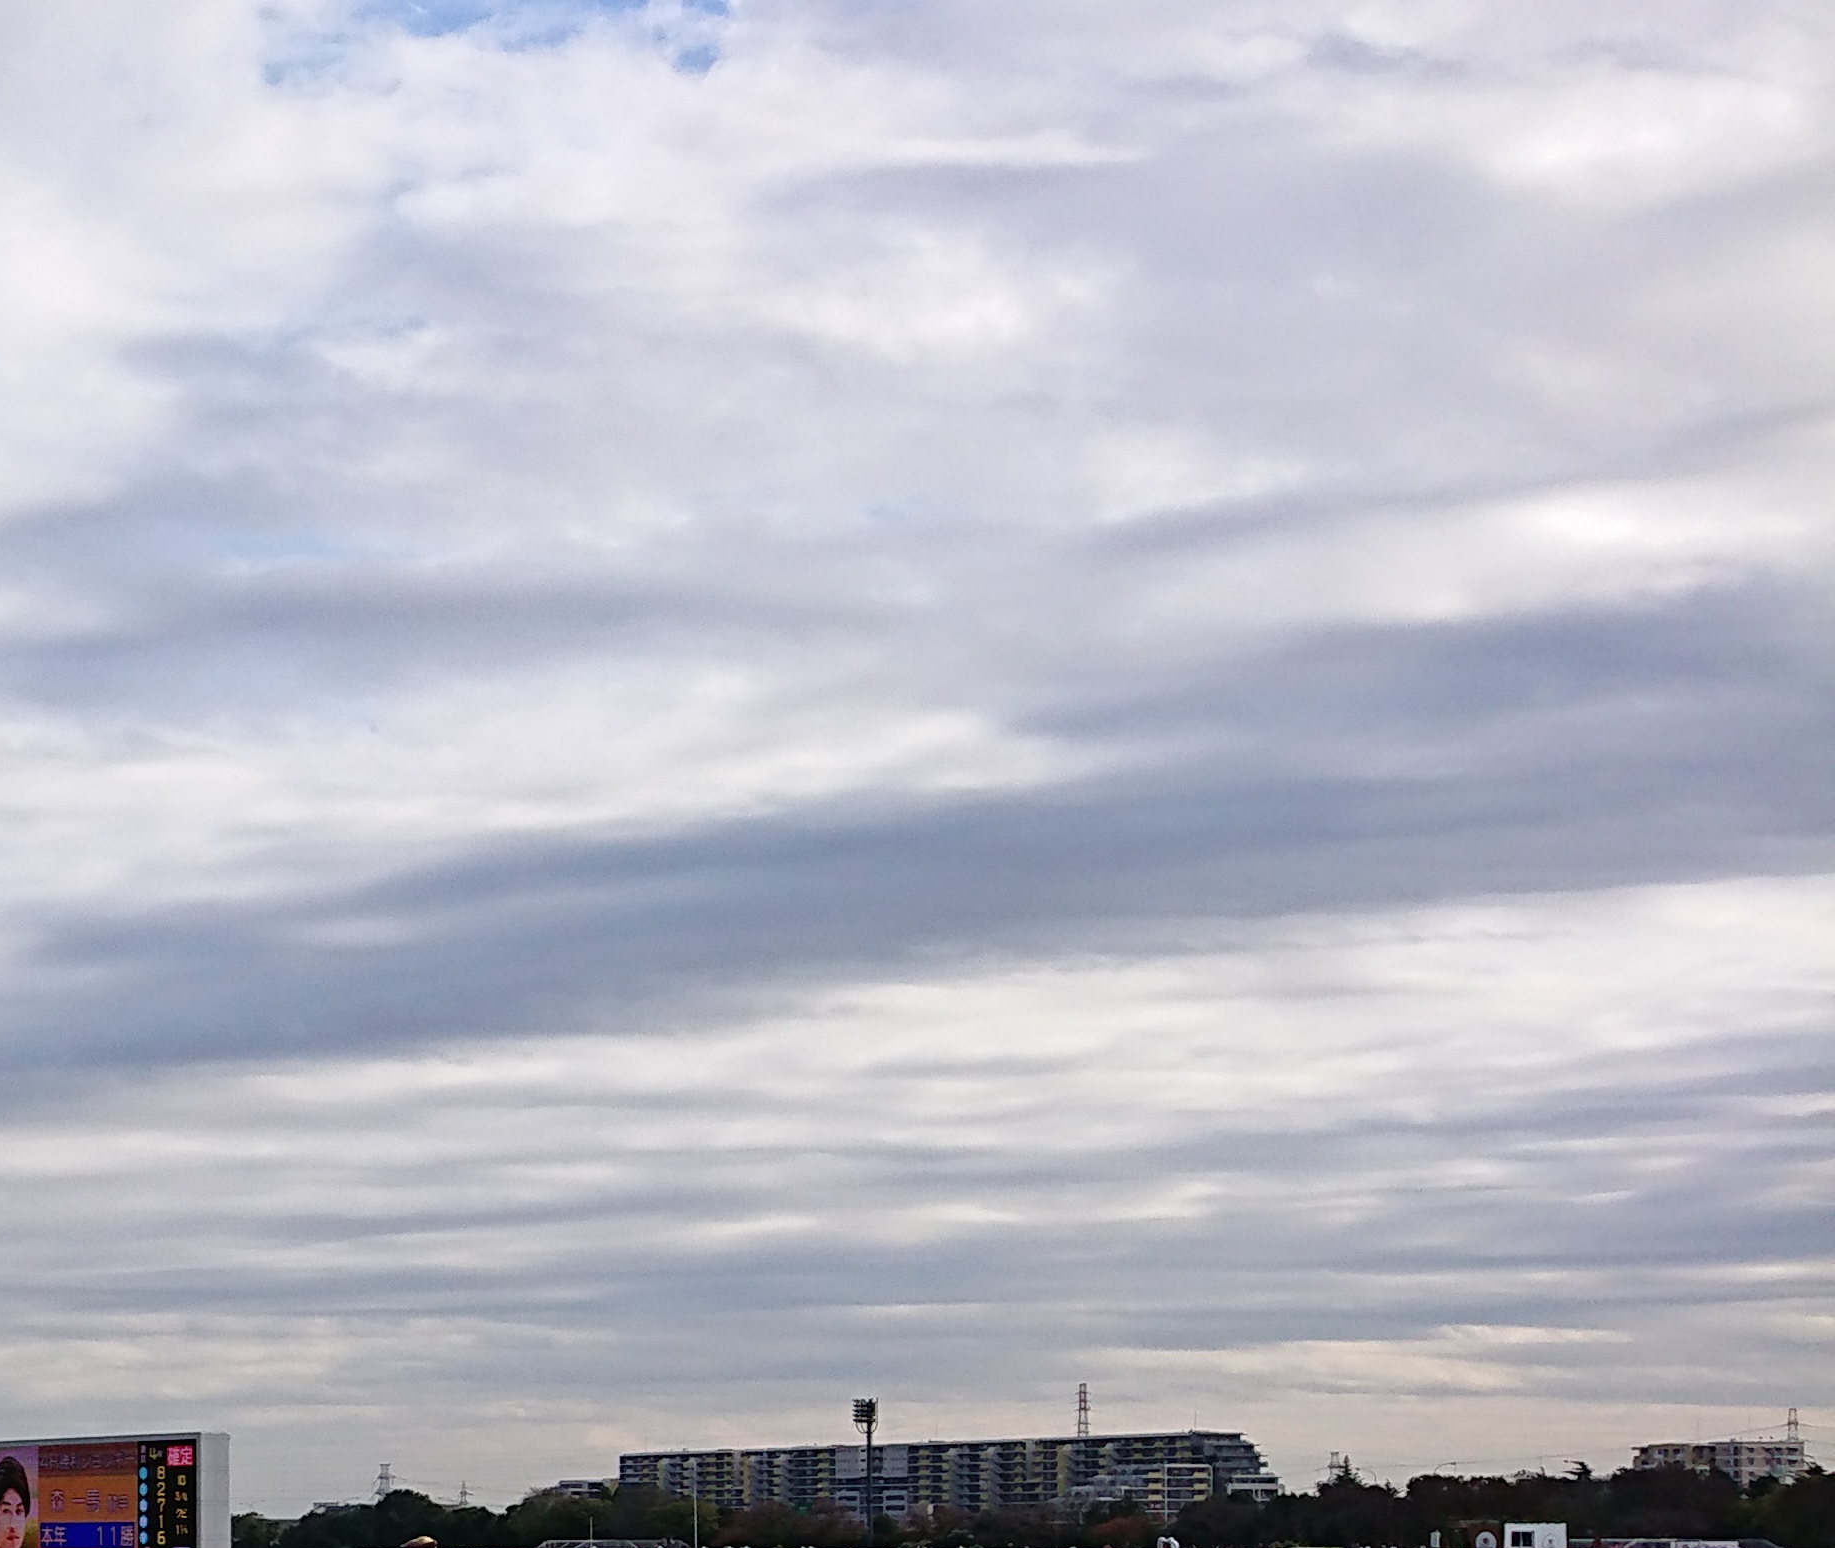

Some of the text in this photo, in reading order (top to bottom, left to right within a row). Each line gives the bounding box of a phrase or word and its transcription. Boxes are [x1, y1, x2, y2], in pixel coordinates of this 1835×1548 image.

[156, 1465, 166, 1480] 8
[156, 1481, 166, 1497] 2
[156, 1497, 166, 1513] 7
[40, 1525, 67, 1547] 本年
[156, 1530, 167, 1545] 6
